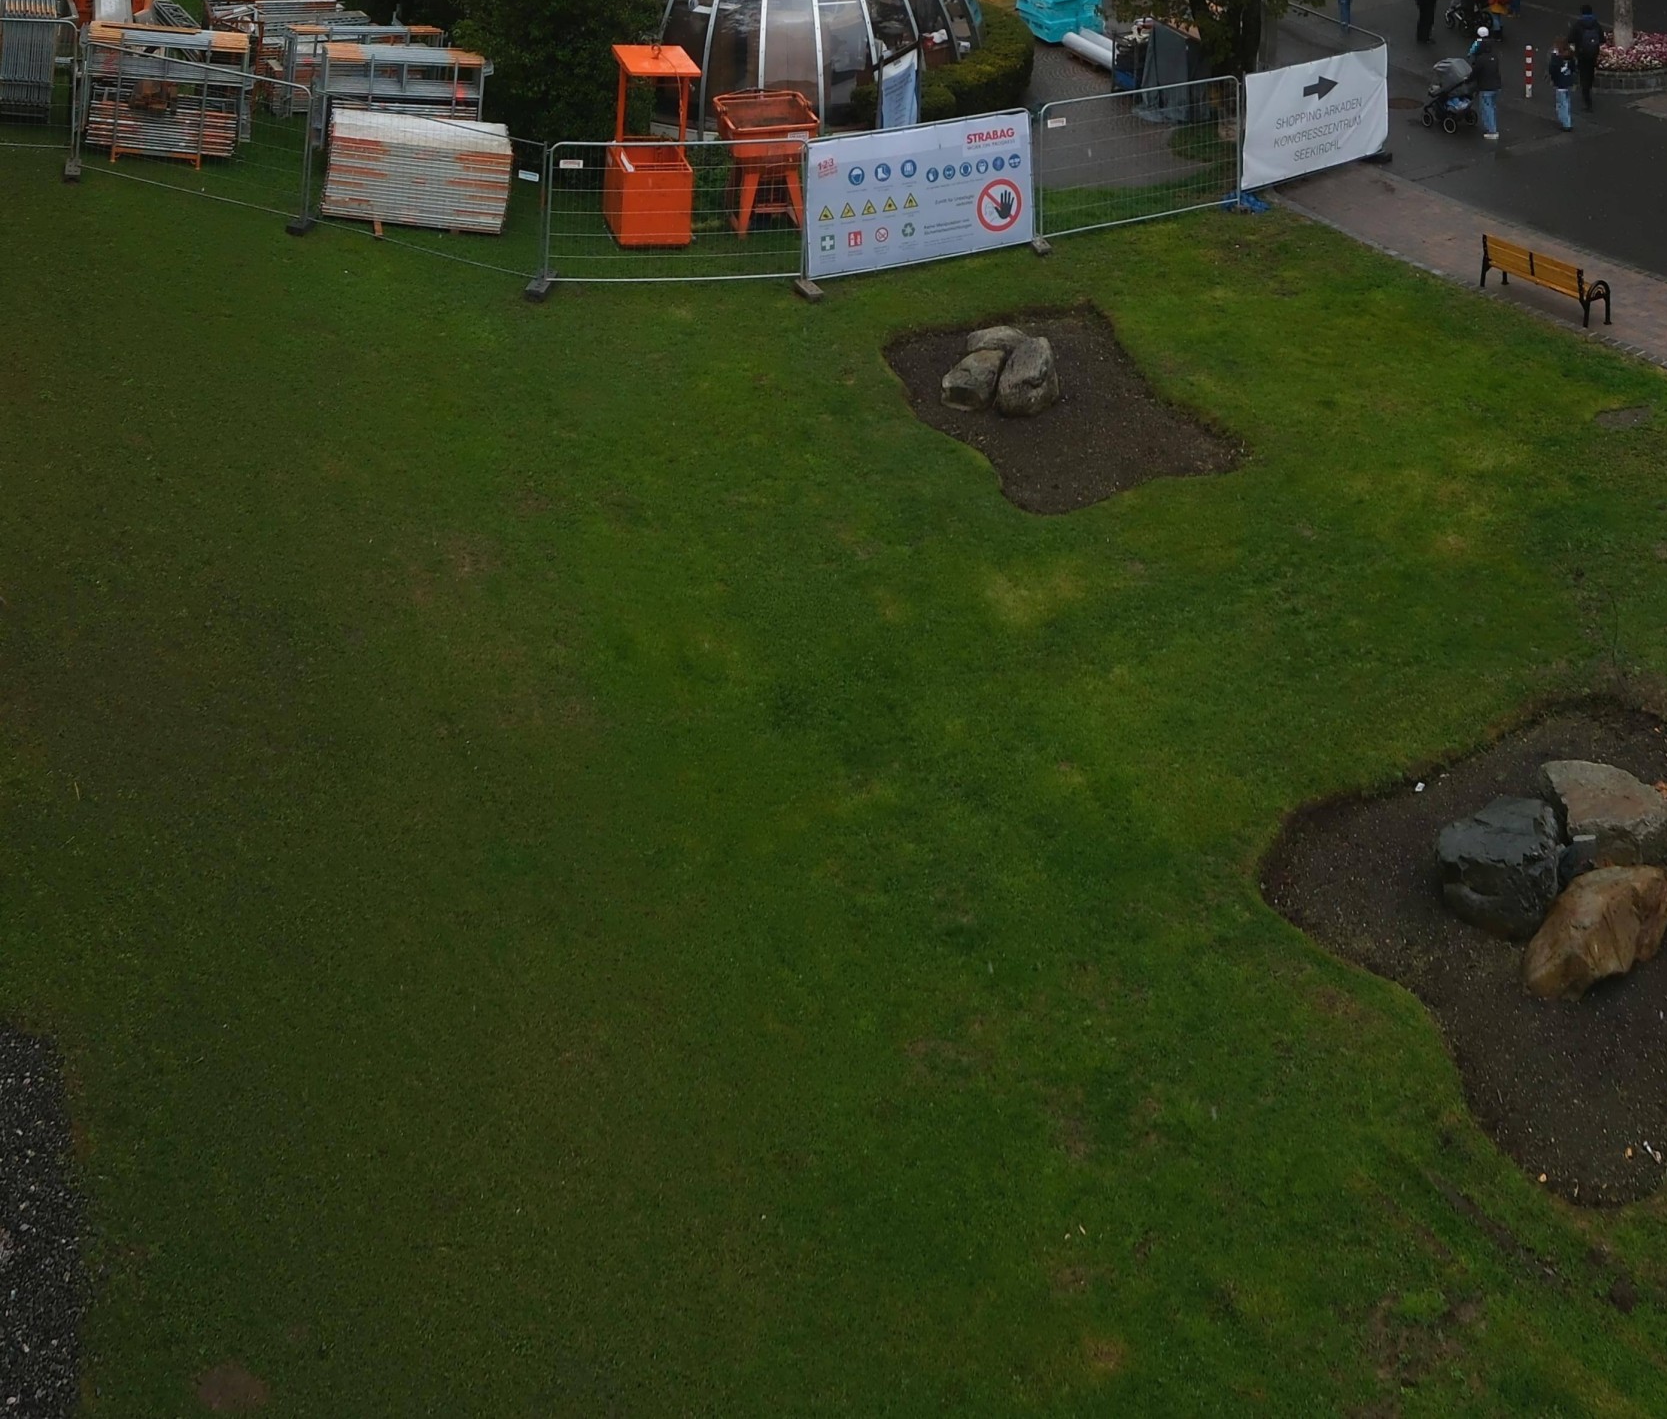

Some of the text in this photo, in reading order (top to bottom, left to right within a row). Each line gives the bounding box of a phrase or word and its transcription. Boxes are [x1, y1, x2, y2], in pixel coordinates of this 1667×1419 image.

[1275, 97, 1362, 130] SHOPPING ARKADEN
[966, 127, 1015, 144] STRABAG
[1274, 115, 1362, 148] KONGRESSZENTRUM
[1293, 140, 1342, 161] SEEKIRCHL
